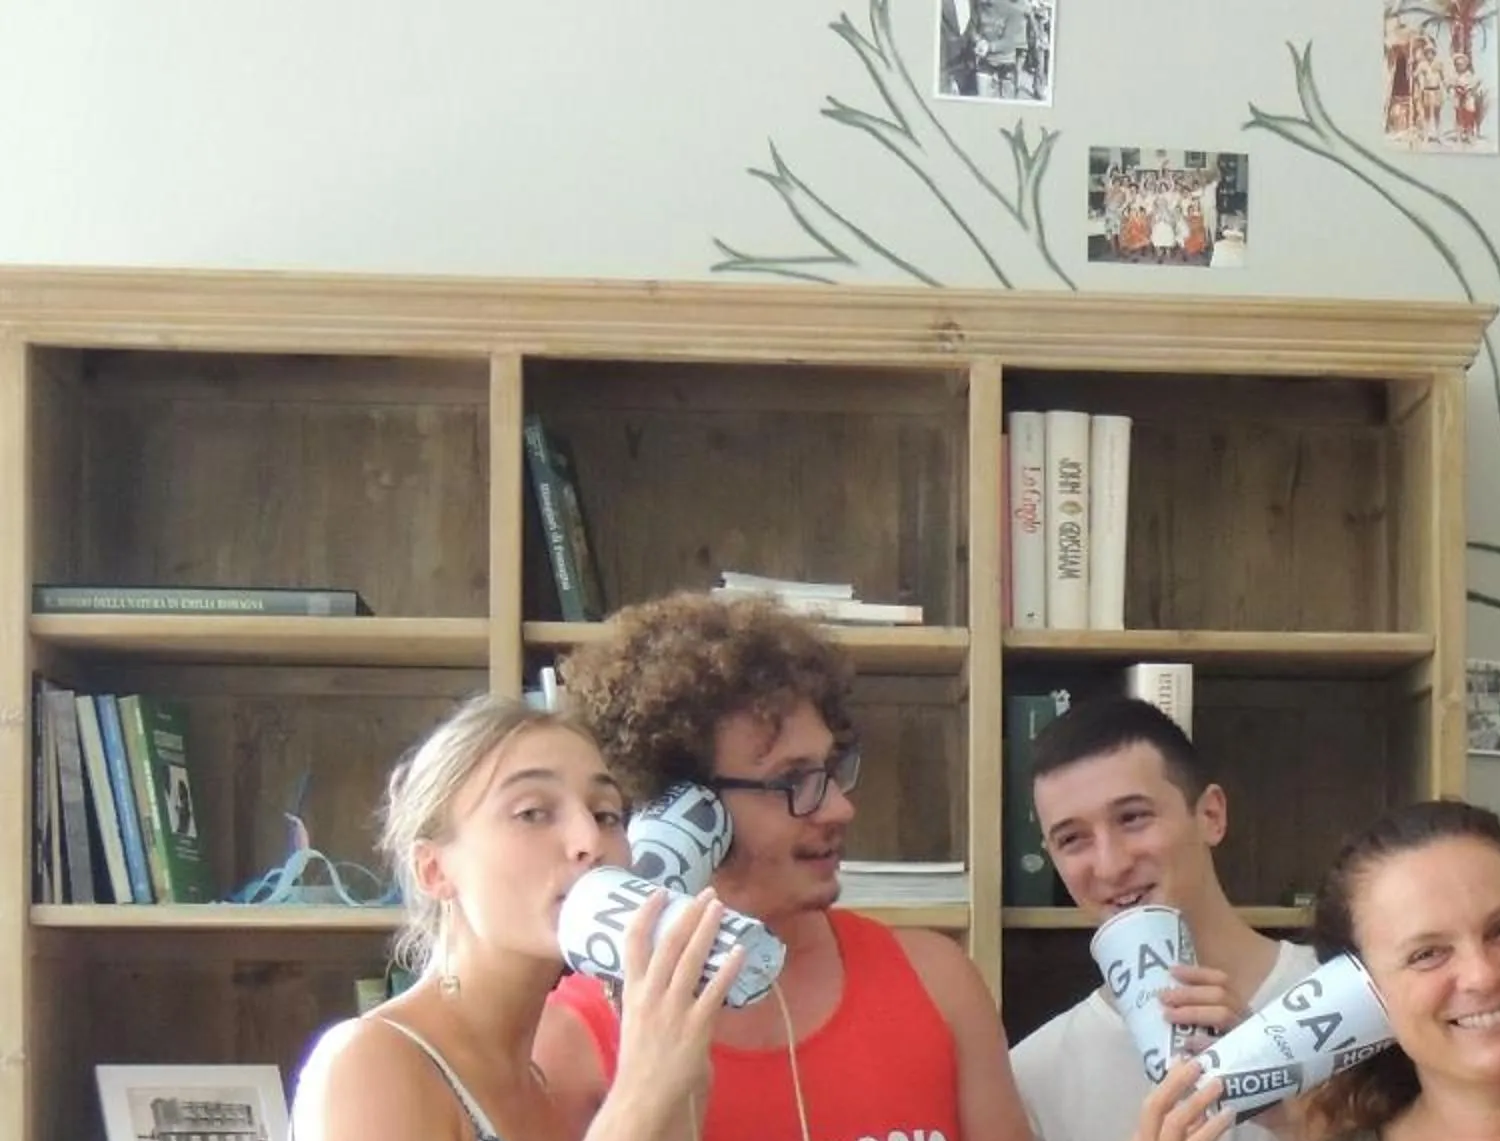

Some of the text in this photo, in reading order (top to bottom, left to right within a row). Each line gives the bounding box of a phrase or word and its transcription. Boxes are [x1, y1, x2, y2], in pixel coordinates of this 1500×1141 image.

[1058, 458, 1082, 579] JOHN GRISHAM
[1225, 1068, 1293, 1096] HOTEL
